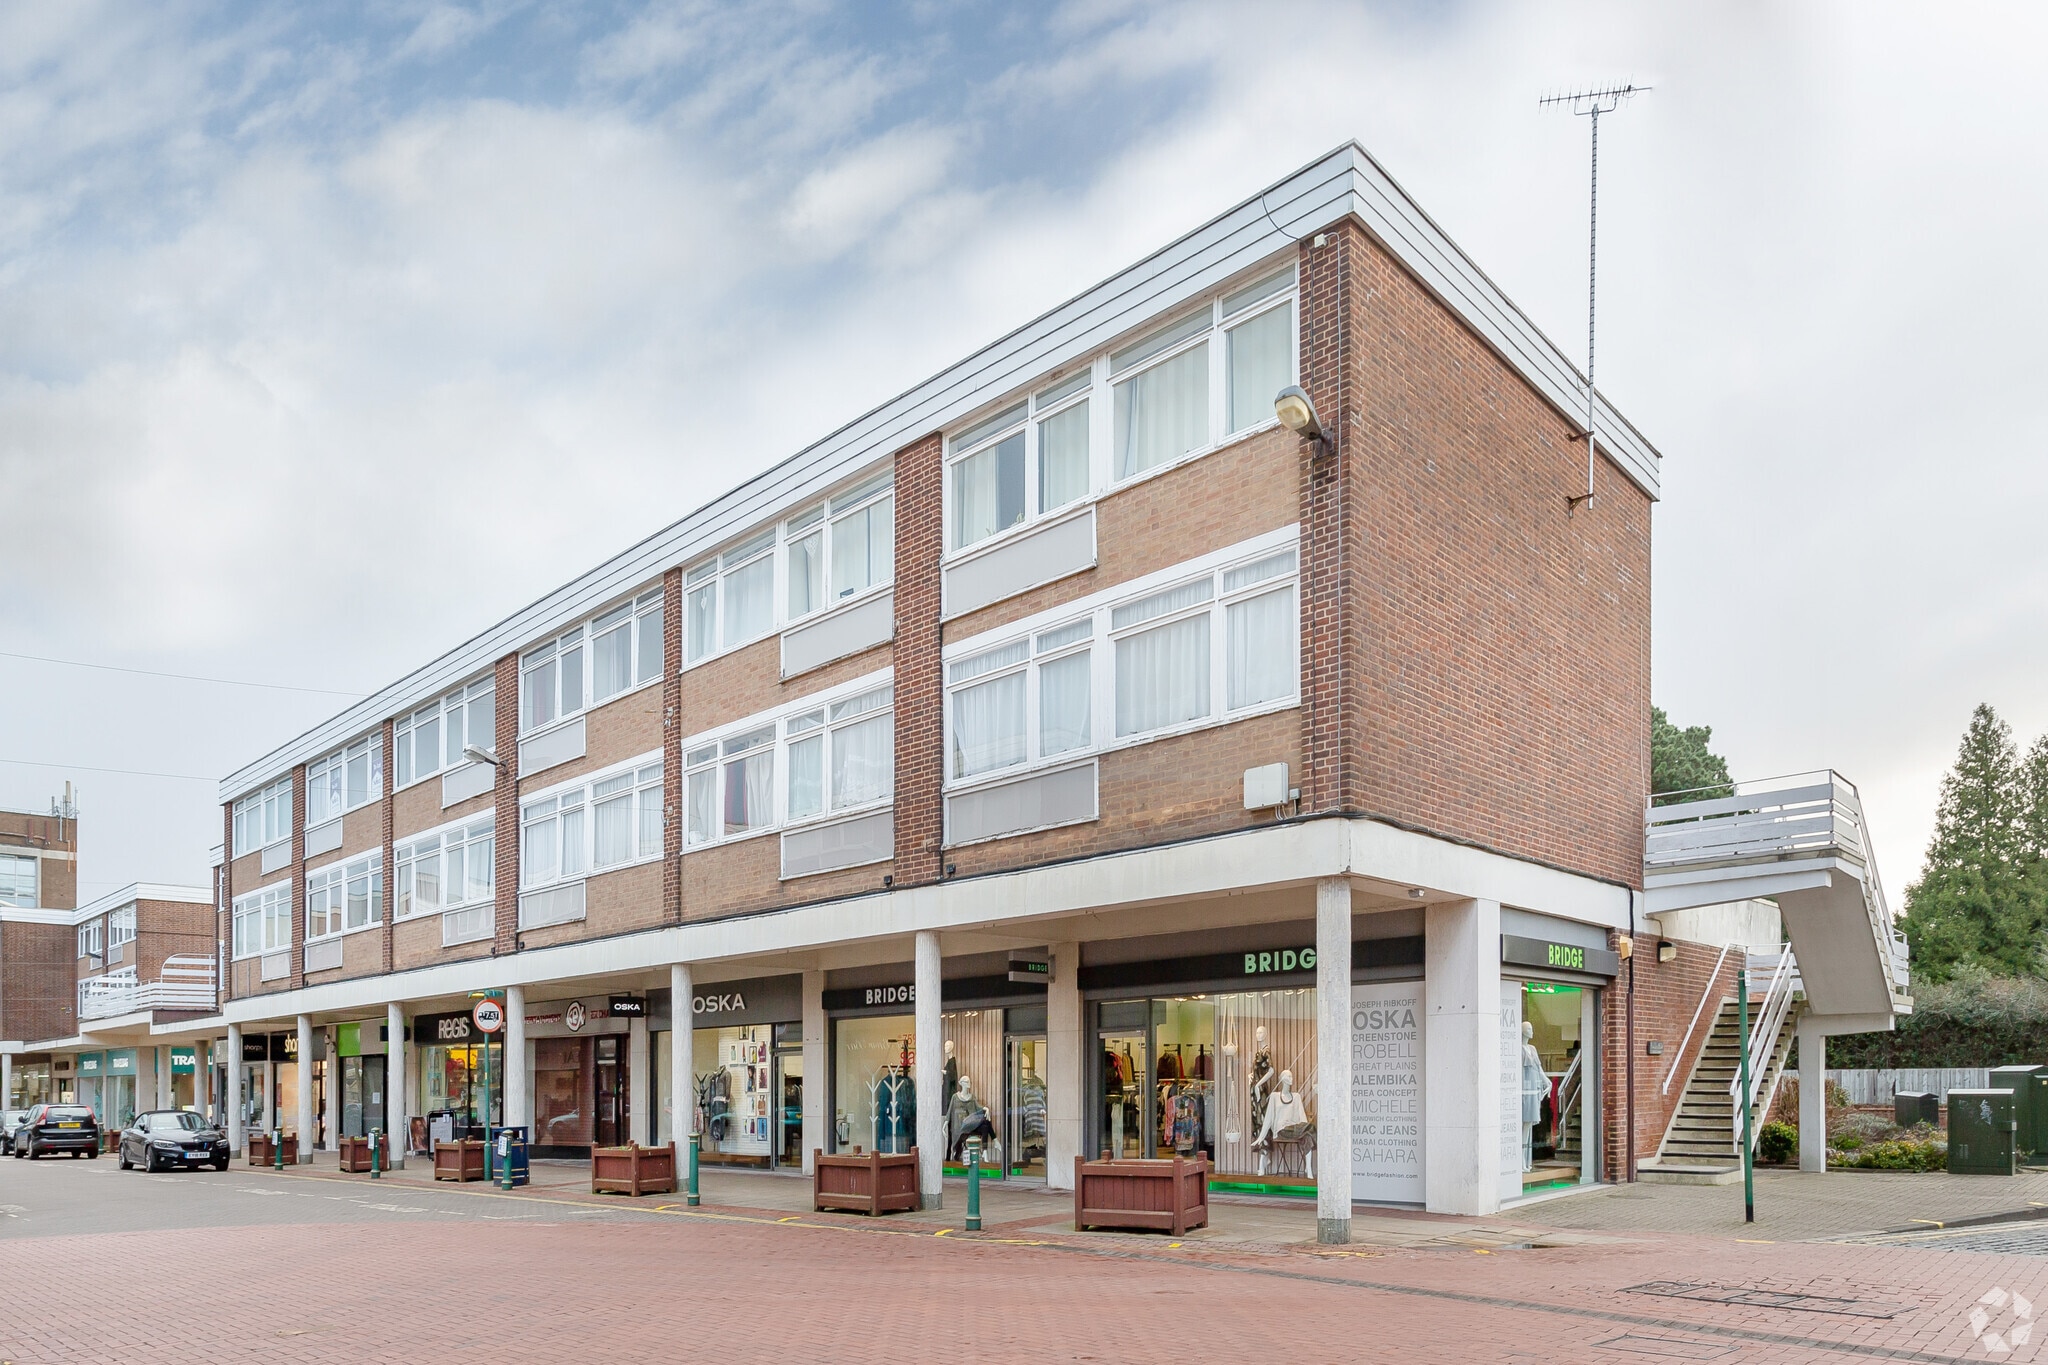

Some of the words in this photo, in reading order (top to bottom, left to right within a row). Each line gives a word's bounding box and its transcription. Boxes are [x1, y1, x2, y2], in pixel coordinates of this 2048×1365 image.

[1244, 948, 1317, 974] BRIDG
[1548, 944, 1583, 969] BRIDGE
[1028, 963, 1048, 972] BRIDGE
[866, 985, 915, 1005] BRIDGE
[614, 1003, 640, 1011] OSKA
[692, 993, 746, 1014] OSKA
[1352, 1001, 1381, 1009] JOSEPH
[1383, 999, 1417, 1007] RIBKOFF
[1353, 1009, 1417, 1030] OSKA
[1500, 1008, 1516, 1028] KA
[1352, 1032, 1417, 1042] CREENSTONE
[1353, 1043, 1417, 1059] ROBELL
[1352, 1063, 1381, 1071] GREAT
[1384, 1062, 1417, 1070] PLAINS
[1352, 1074, 1417, 1085] ALEMBIKA
[1352, 1100, 1417, 1113] MICHELE
[1352, 1125, 1376, 1135] MAC
[1380, 1126, 1418, 1136] JEANS
[1377, 1139, 1418, 1147] CLOTHING
[1352, 1148, 1418, 1164] SAHARA
